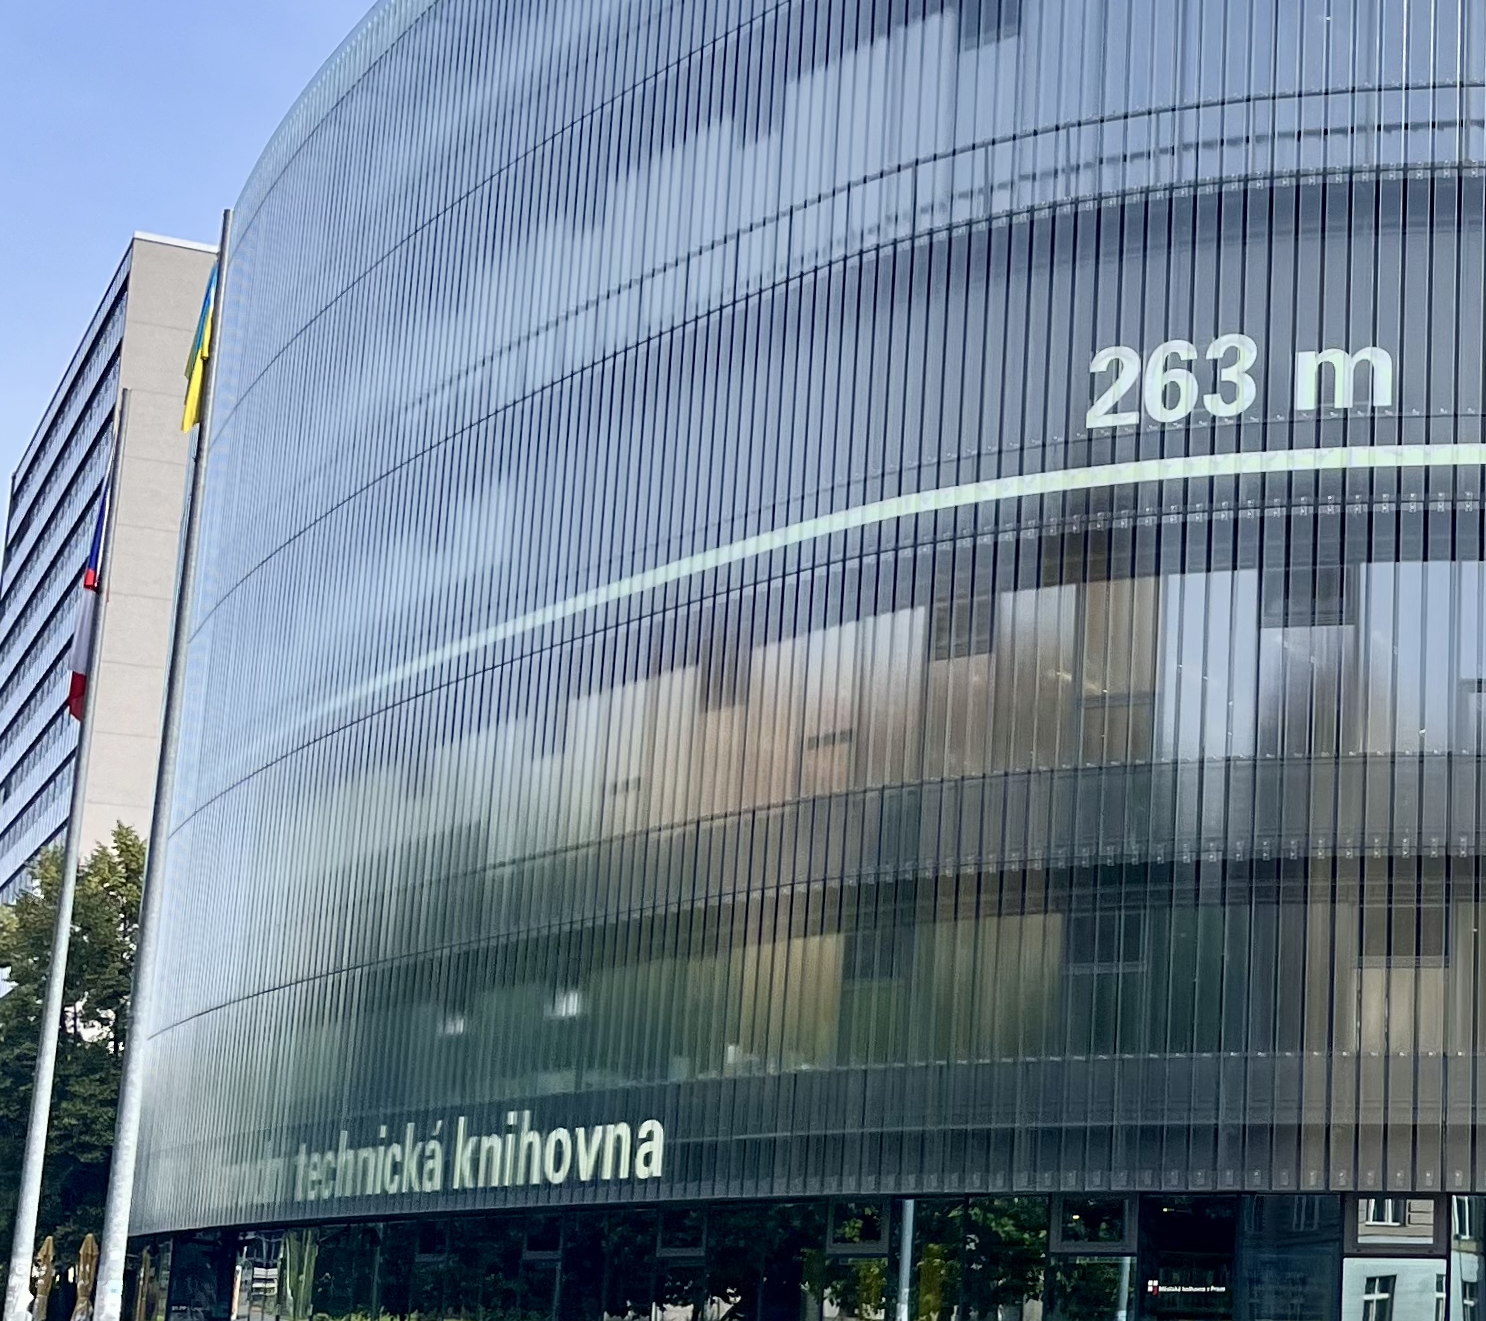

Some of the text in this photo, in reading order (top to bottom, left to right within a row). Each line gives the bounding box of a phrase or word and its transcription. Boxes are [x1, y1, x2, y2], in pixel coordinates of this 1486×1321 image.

[1086, 333, 1393, 429] 263 m
[294, 1119, 443, 1203] technická
[453, 1109, 664, 1190] knihovna
